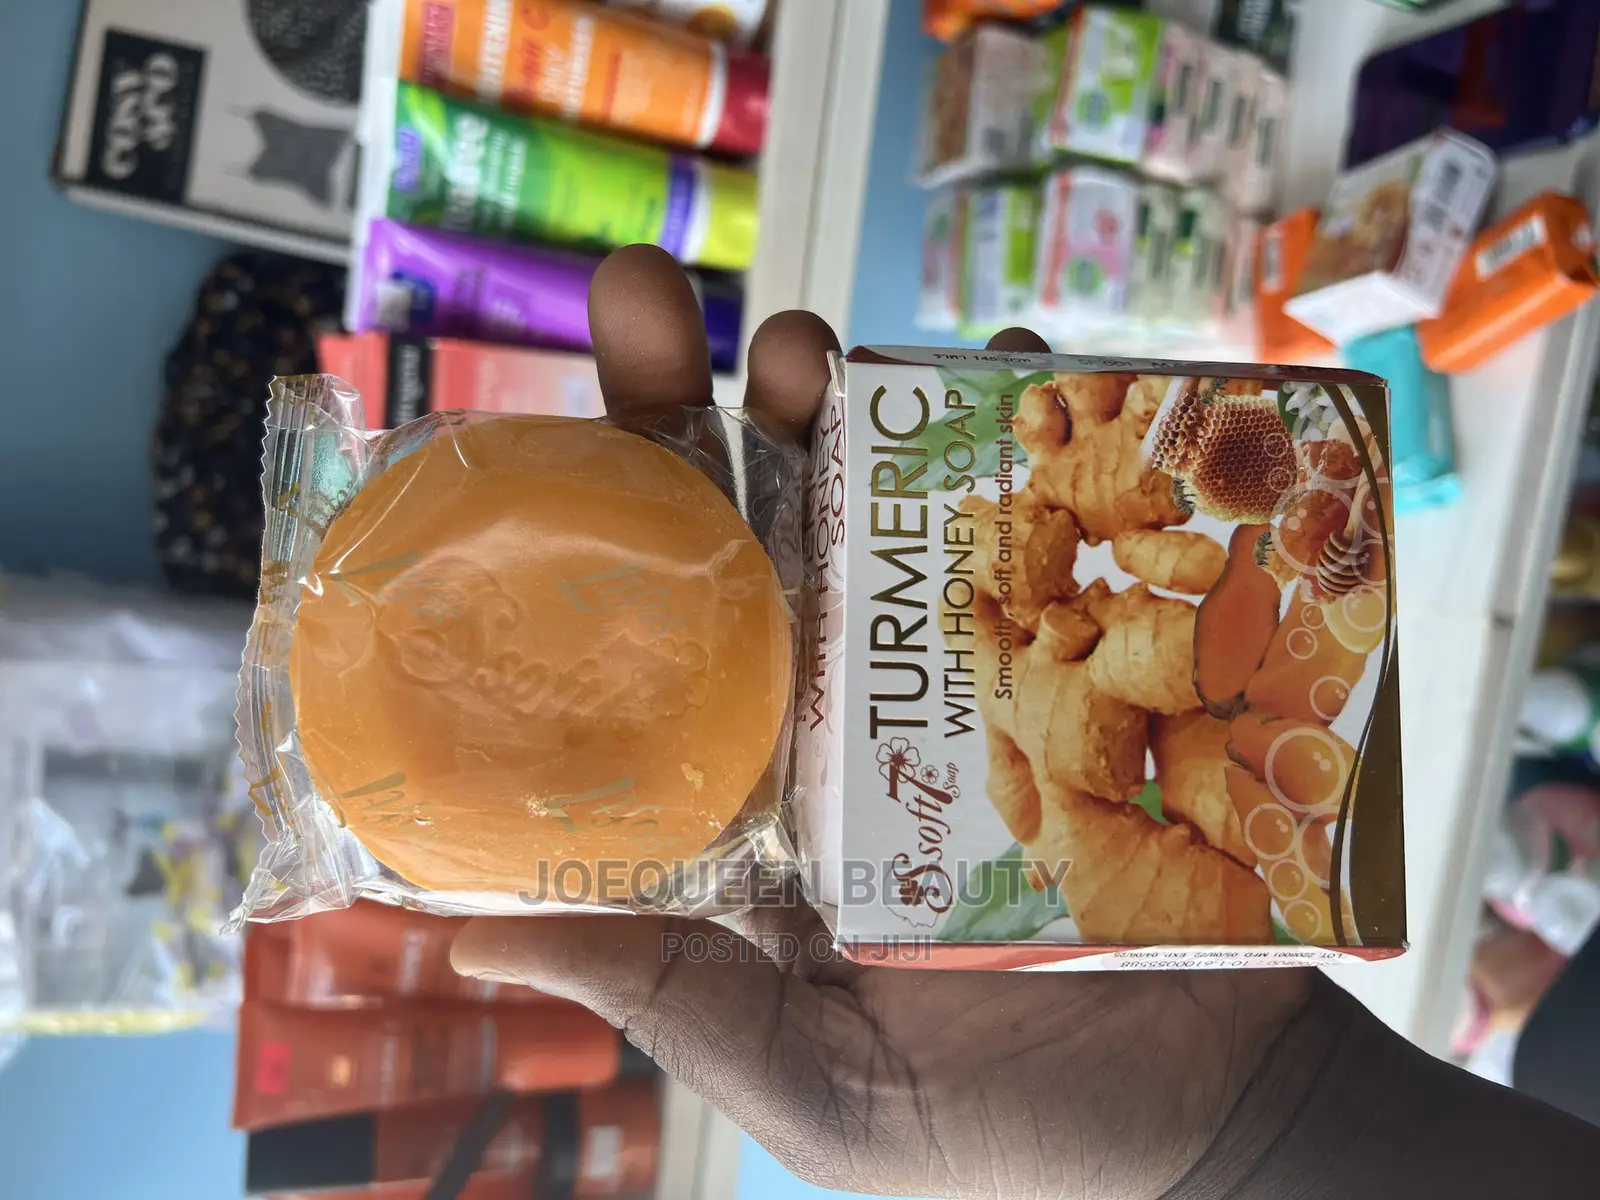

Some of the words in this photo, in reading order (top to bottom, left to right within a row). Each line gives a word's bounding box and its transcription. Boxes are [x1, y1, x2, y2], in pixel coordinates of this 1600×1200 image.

[944, 387, 977, 493] SOAP
[993, 391, 1013, 433] skin
[815, 424, 830, 593] HONEY
[829, 403, 846, 545] SOAP
[992, 437, 1014, 516] radiant
[869, 383, 931, 739] TURMERIC
[943, 505, 976, 635] HONEY
[993, 519, 1014, 563] and
[993, 565, 1014, 605] soft
[943, 649, 976, 738] WITH
[993, 612, 1017, 700] Smooth,
[942, 760, 961, 799] Soap
